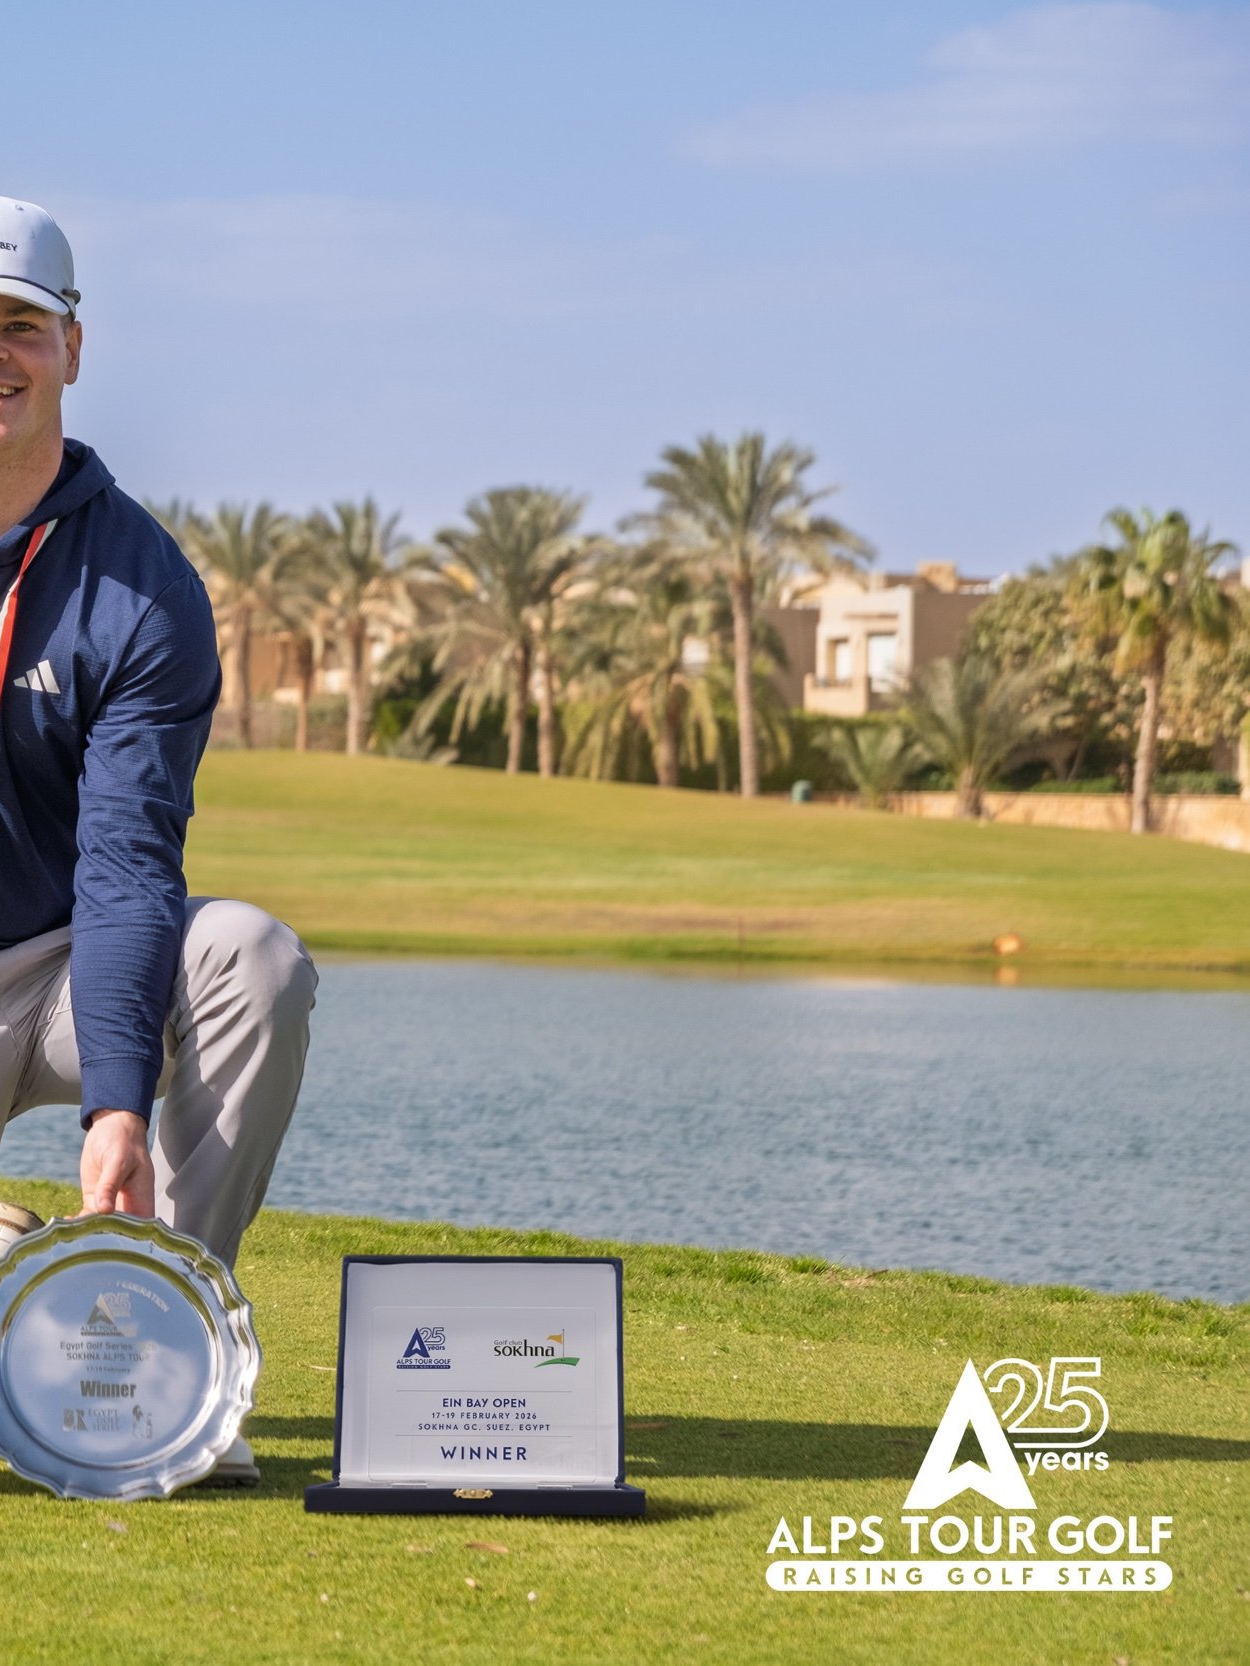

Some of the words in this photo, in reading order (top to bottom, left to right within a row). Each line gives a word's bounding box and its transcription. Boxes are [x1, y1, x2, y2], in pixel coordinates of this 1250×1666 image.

[60, 1341, 84, 1351] Egypt
[86, 1341, 103, 1350] Golf
[105, 1342, 133, 1350] Series
[494, 1339, 555, 1357] sokhna
[66, 1353, 100, 1361] SOKHNA
[103, 1353, 126, 1361] ALPS
[80, 1380, 137, 1398] Winner
[442, 1398, 462, 1408] EIN
[466, 1398, 488, 1408] BAY
[492, 1398, 526, 1408] OPEN
[431, 1411, 456, 1419] 17-19
[460, 1412, 510, 1420] FEBRUARY
[514, 1412, 537, 1420] 2026
[418, 1423, 459, 1431] SOKHNA
[519, 1424, 551, 1432] EGYPT
[440, 1445, 527, 1461] WINNER
